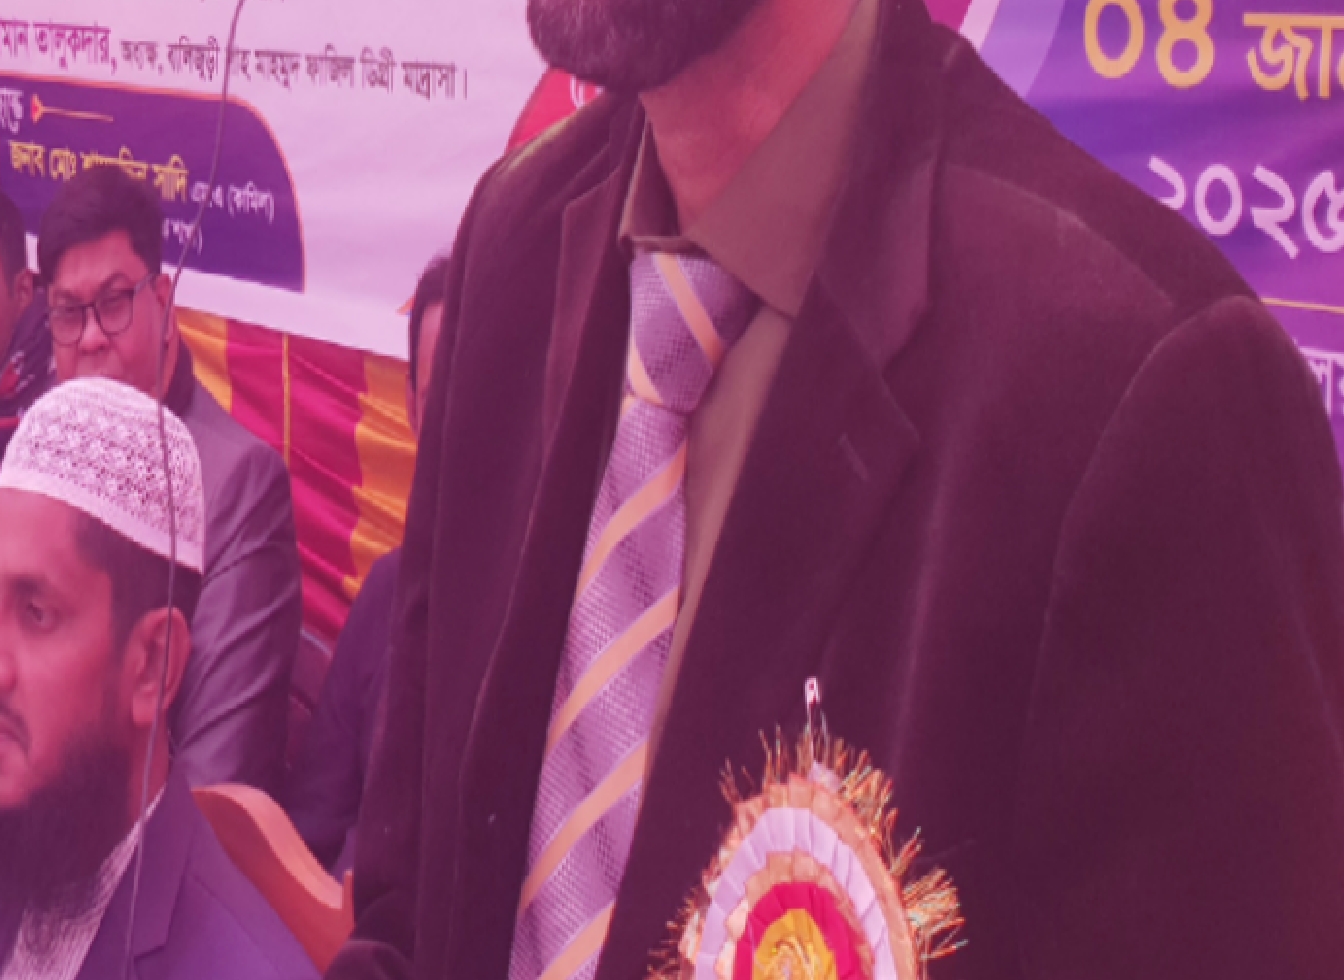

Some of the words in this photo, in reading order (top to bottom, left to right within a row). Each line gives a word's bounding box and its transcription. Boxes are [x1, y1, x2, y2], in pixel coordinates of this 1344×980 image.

[305, 42, 356, 89] ফাজিল
[1243, 12, 1344, 102] জা
[8, 139, 46, 178] জনাব
